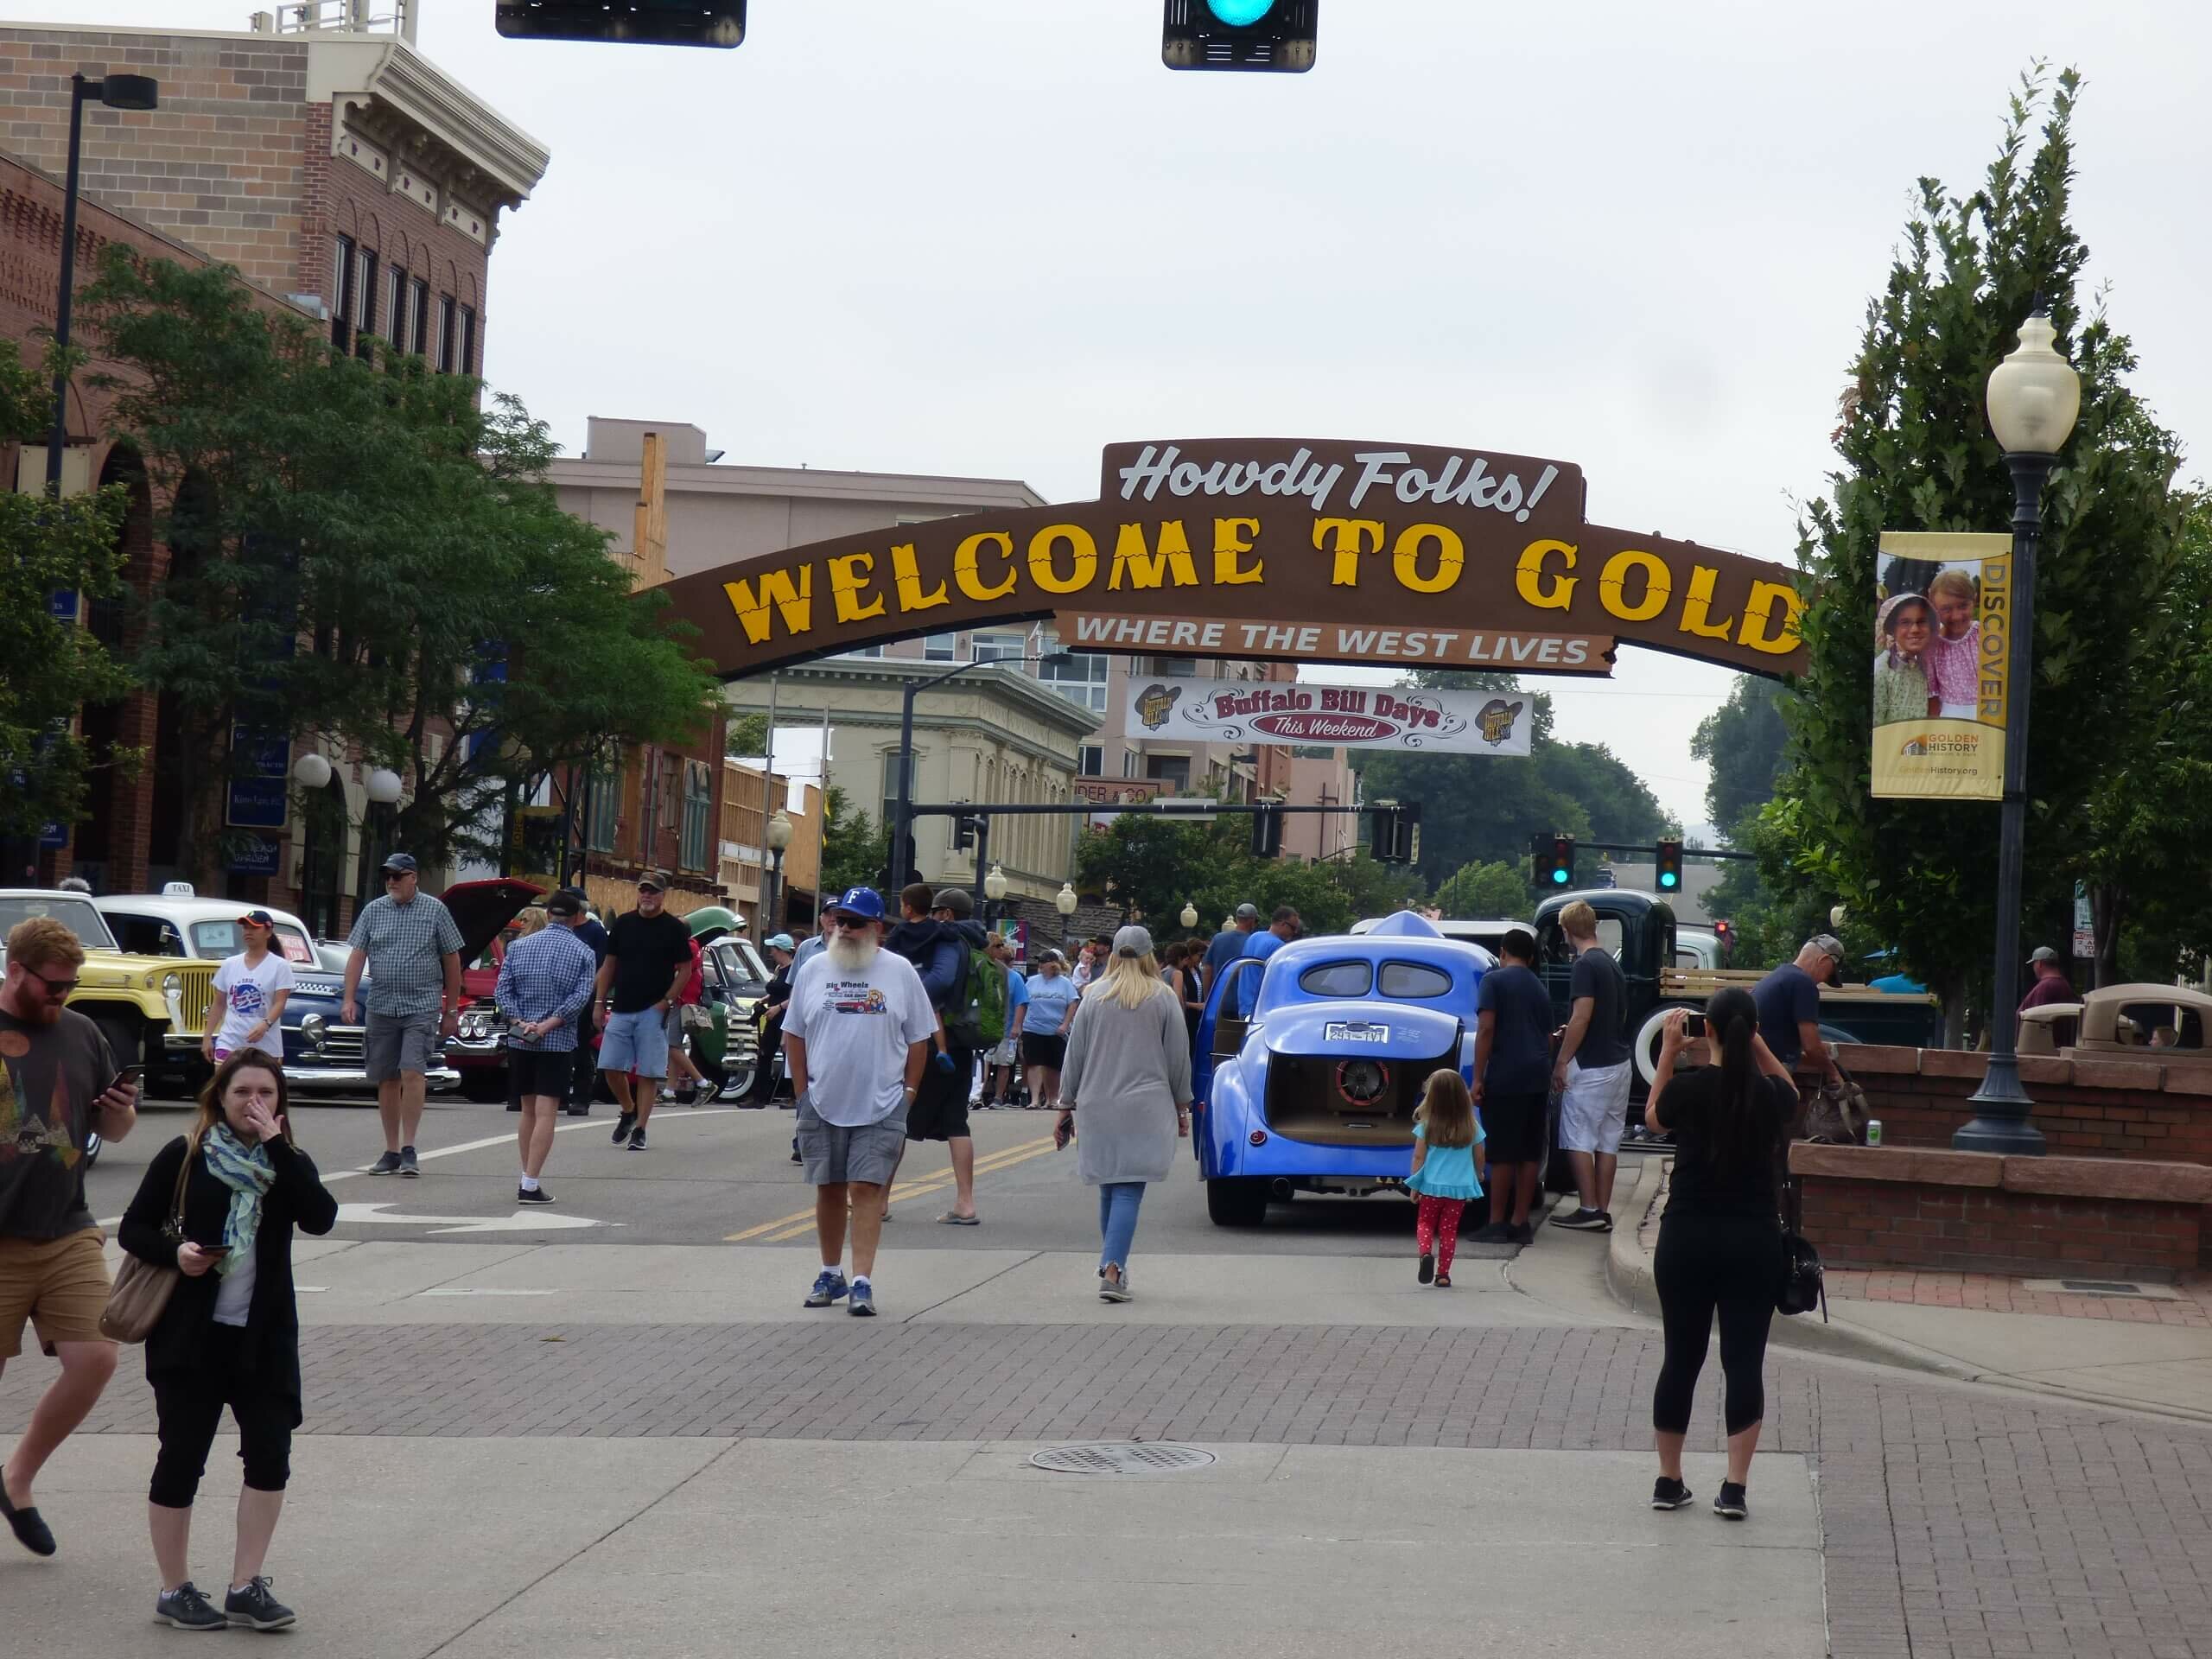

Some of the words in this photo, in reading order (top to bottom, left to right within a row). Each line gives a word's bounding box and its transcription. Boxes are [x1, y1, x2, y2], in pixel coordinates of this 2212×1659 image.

[1120, 446, 1344, 512] Howdy
[1349, 452, 1559, 524] Folks!
[721, 518, 1265, 645] WELCOME
[1312, 518, 1465, 594] TO
[1516, 539, 1809, 655] GOLD
[1077, 617, 1225, 647] WHERE
[1241, 625, 1322, 652] THE
[1338, 629, 1459, 658] WEST
[1468, 635, 1589, 664] LIVES
[1981, 564, 2005, 716] DISCOVER
[1215, 689, 1313, 719] Buffalo
[1320, 689, 1367, 714] Bill
[1373, 693, 1441, 728] Days
[1274, 717, 1305, 734] This
[1309, 718, 1380, 738] Weekend
[1928, 742, 1979, 753] HISTORY
[1929, 734, 1979, 743] GOLDEN
[1075, 785, 1106, 801] DER
[1113, 791, 1121, 802] &
[172, 884, 190, 893] TAXI
[847, 890, 861, 905] F
